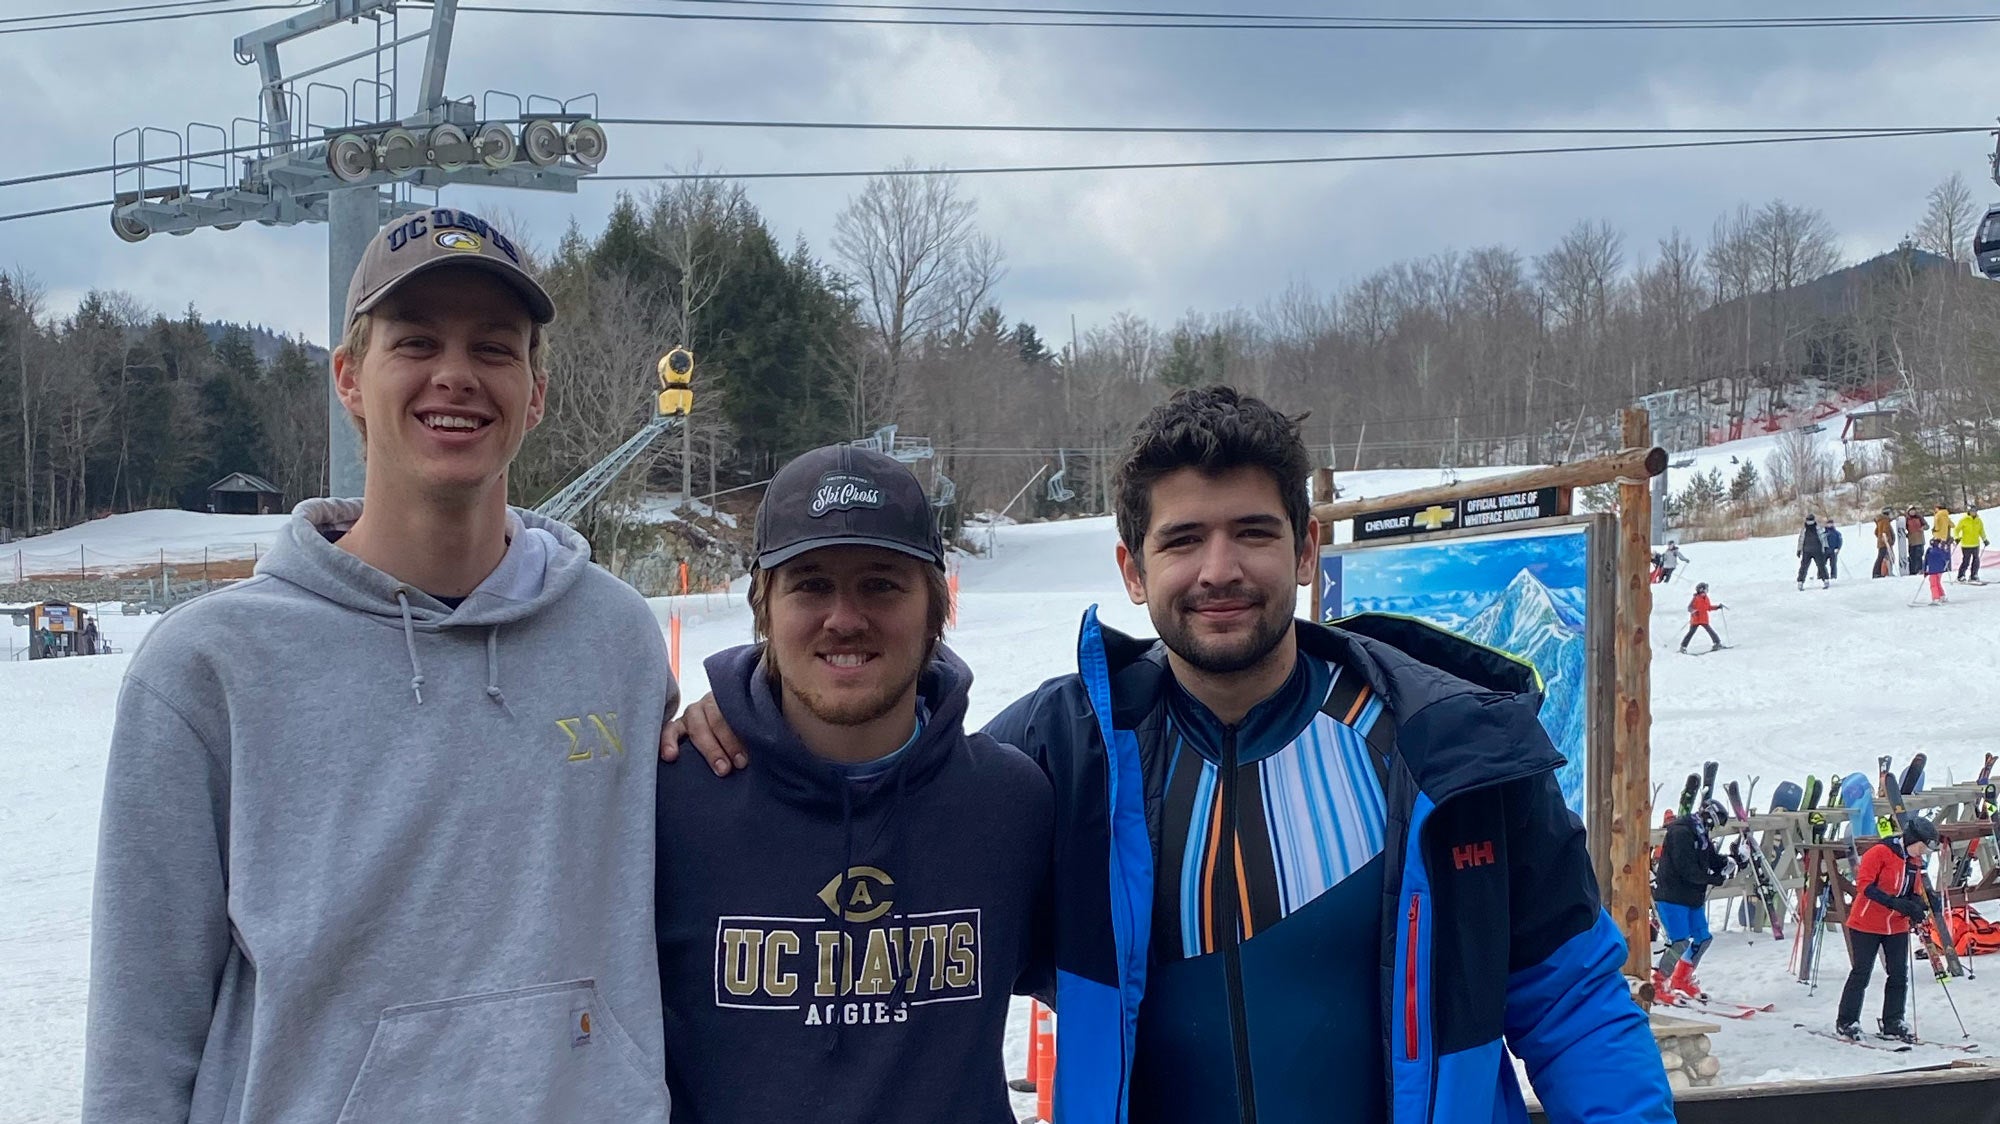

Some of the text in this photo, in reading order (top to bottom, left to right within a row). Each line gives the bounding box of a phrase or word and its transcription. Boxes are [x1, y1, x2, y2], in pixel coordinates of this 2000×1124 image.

[387, 208, 519, 263] UC DAVIS
[812, 483, 879, 512] Ski Cross
[1467, 491, 1538, 513] OFFICIAL VEHICLE OF
[1365, 516, 1410, 532] CHEVROLET
[1464, 505, 1540, 527] WHITEFACE MOUNTAIN
[1452, 841, 1495, 870] HH
[723, 922, 975, 997] UC DAVIS
